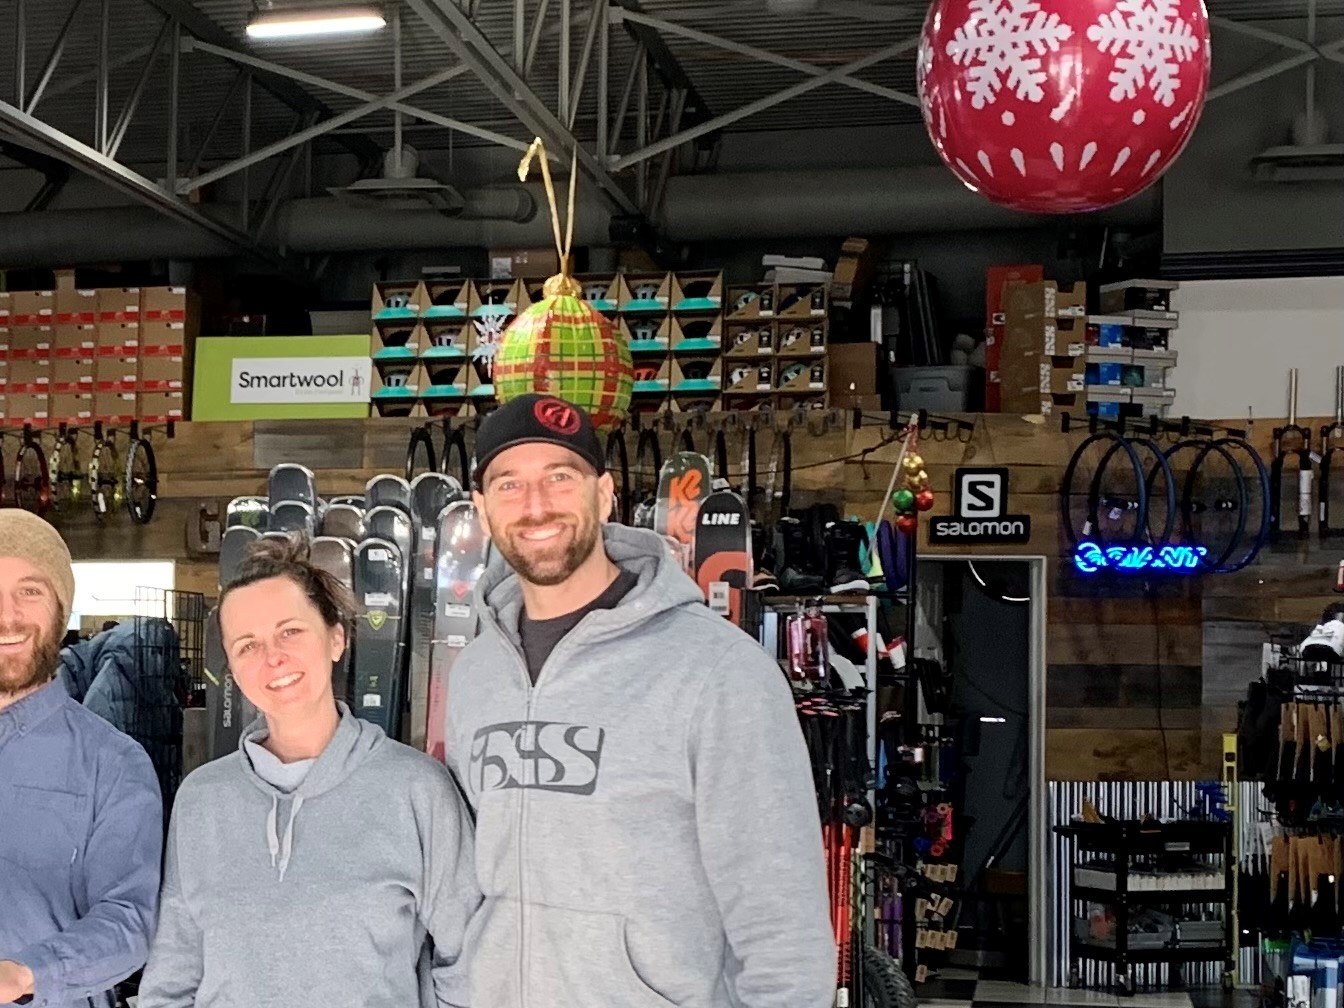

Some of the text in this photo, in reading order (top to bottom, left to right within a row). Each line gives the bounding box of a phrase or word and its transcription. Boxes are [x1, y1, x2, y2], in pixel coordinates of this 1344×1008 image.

[238, 370, 344, 388] Smartwool
[701, 512, 741, 525] LINE
[936, 521, 1024, 536] salomon
[222, 674, 233, 727] salomon
